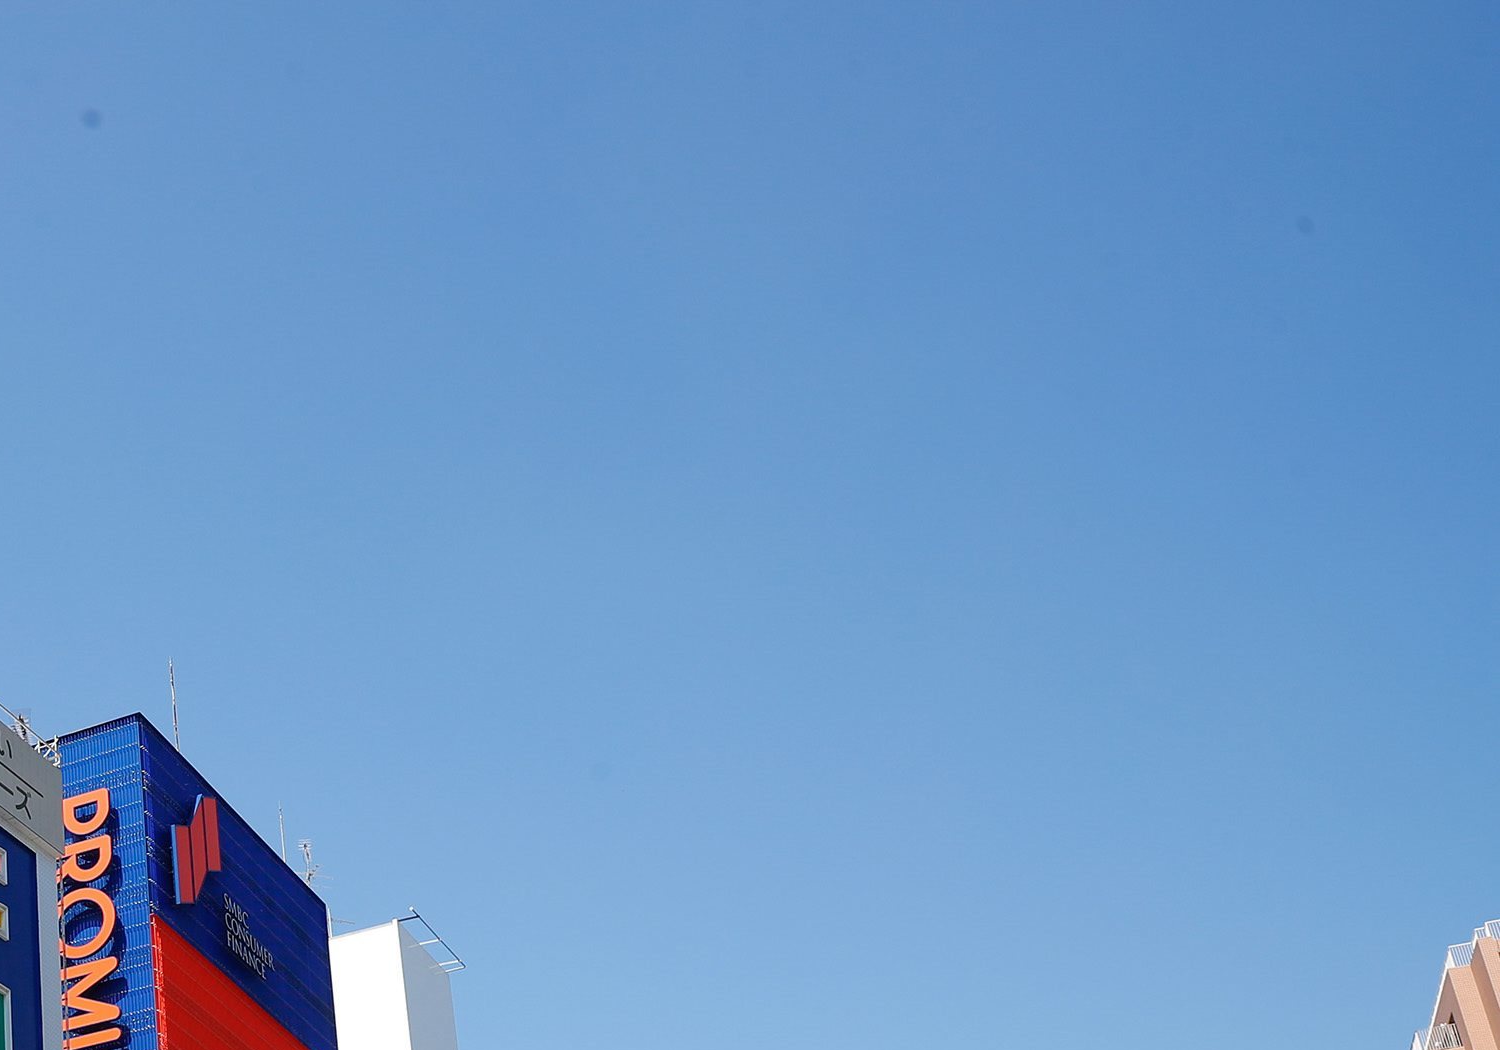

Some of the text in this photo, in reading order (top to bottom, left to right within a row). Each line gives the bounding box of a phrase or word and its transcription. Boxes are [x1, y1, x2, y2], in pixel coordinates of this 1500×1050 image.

[223, 892, 250, 930] SMBC
[224, 911, 276, 972] CONSUMER
[225, 930, 268, 981] FINANCE
